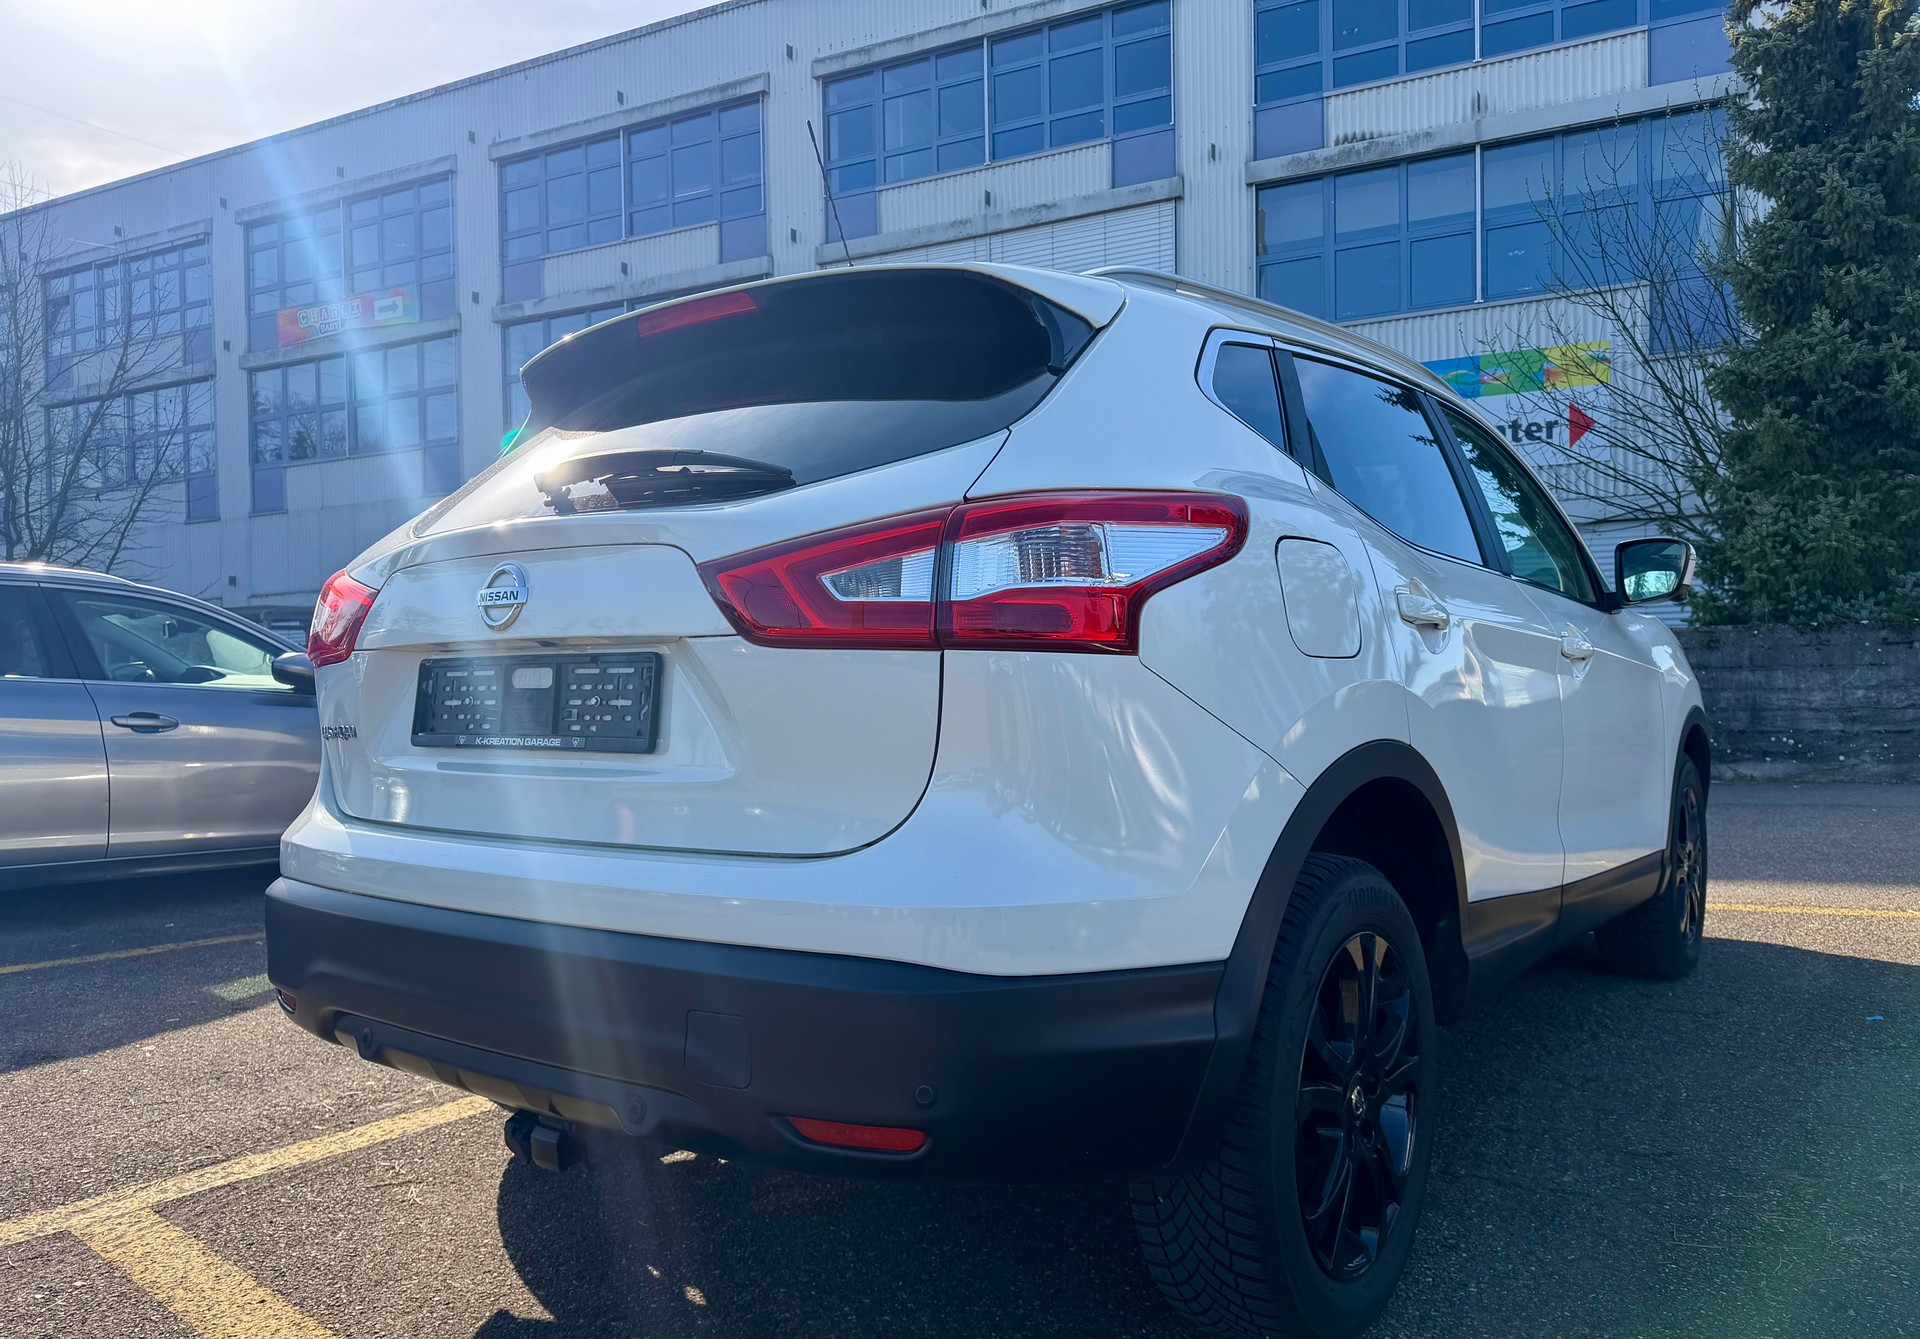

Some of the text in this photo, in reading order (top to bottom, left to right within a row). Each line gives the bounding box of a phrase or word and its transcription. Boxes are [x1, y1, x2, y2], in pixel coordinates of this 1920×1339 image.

[480, 590, 519, 602] NISSAN
[475, 737, 561, 746] K-KREATION GARAGE
